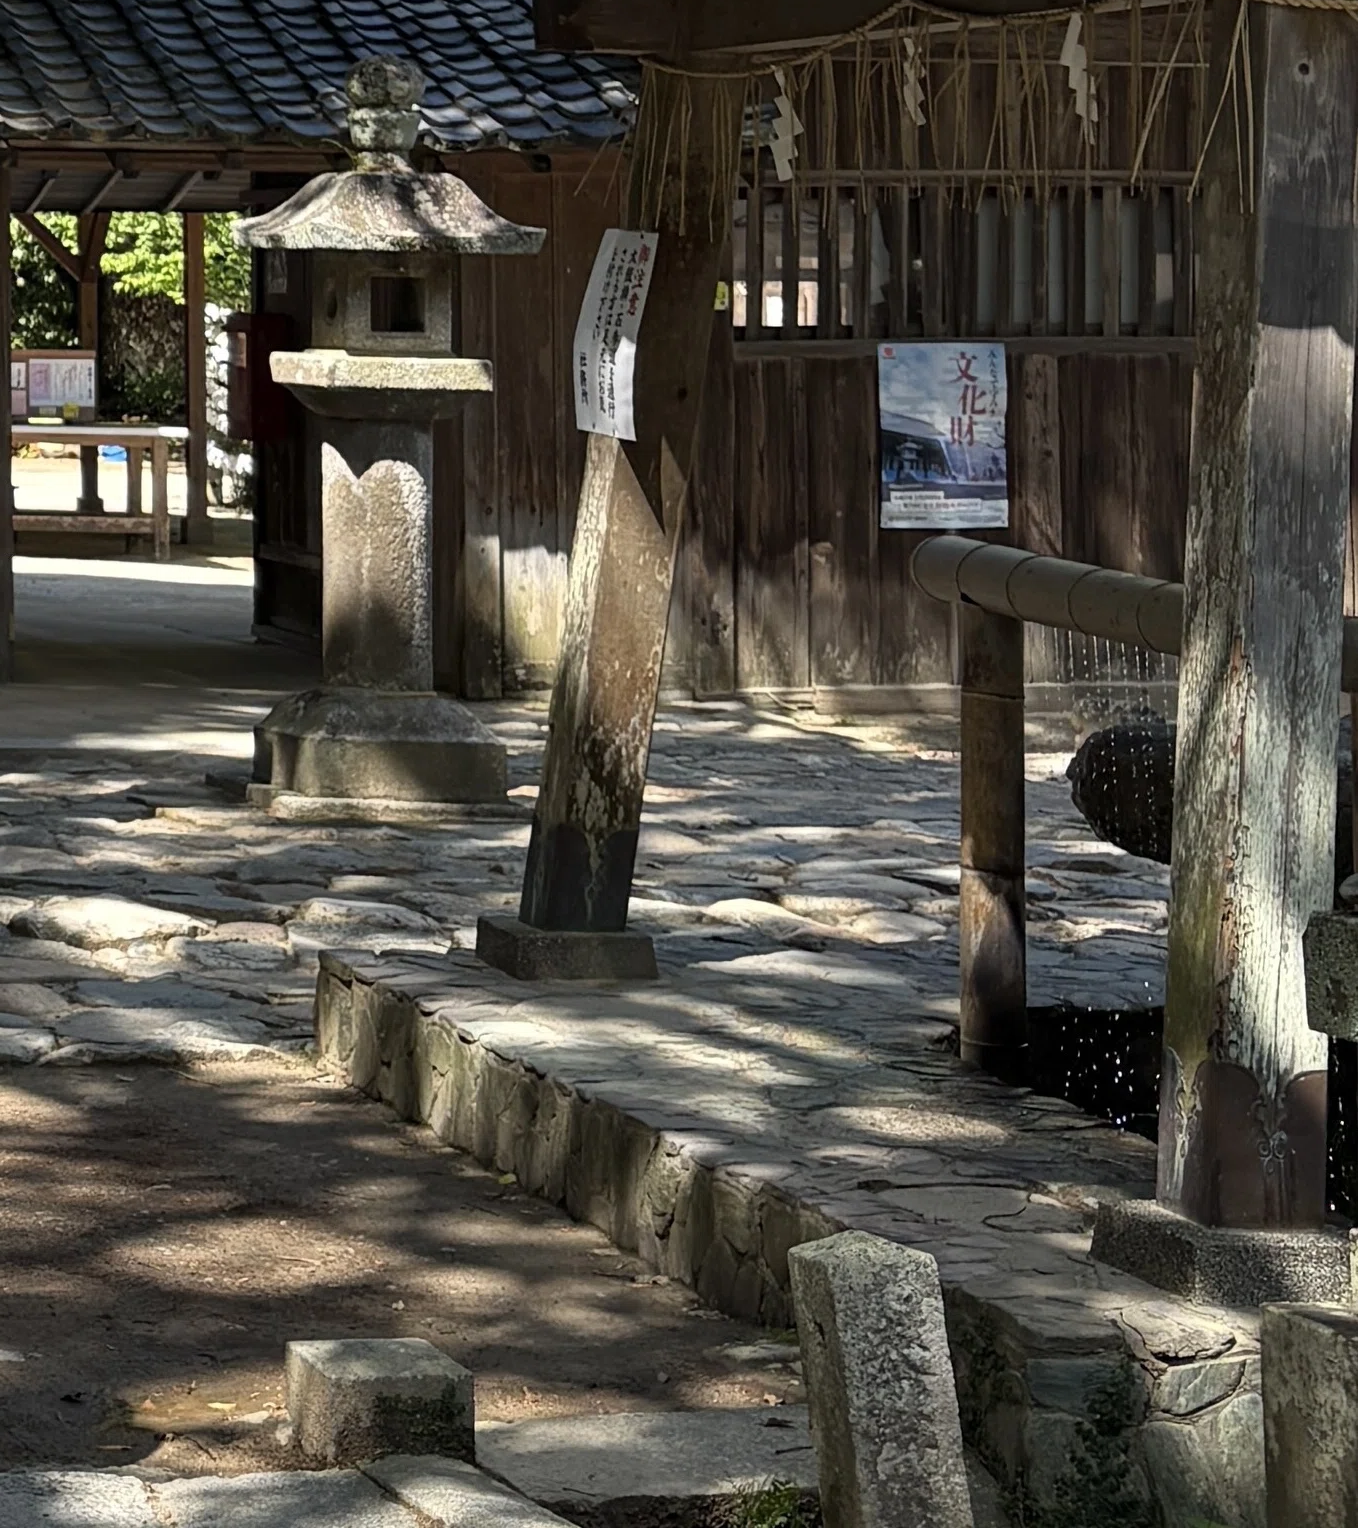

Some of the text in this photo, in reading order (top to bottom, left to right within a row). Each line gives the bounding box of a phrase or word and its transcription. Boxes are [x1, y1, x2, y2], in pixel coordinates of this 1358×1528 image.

[627, 244, 650, 317] 御注意
[948, 351, 987, 447] 文化財
